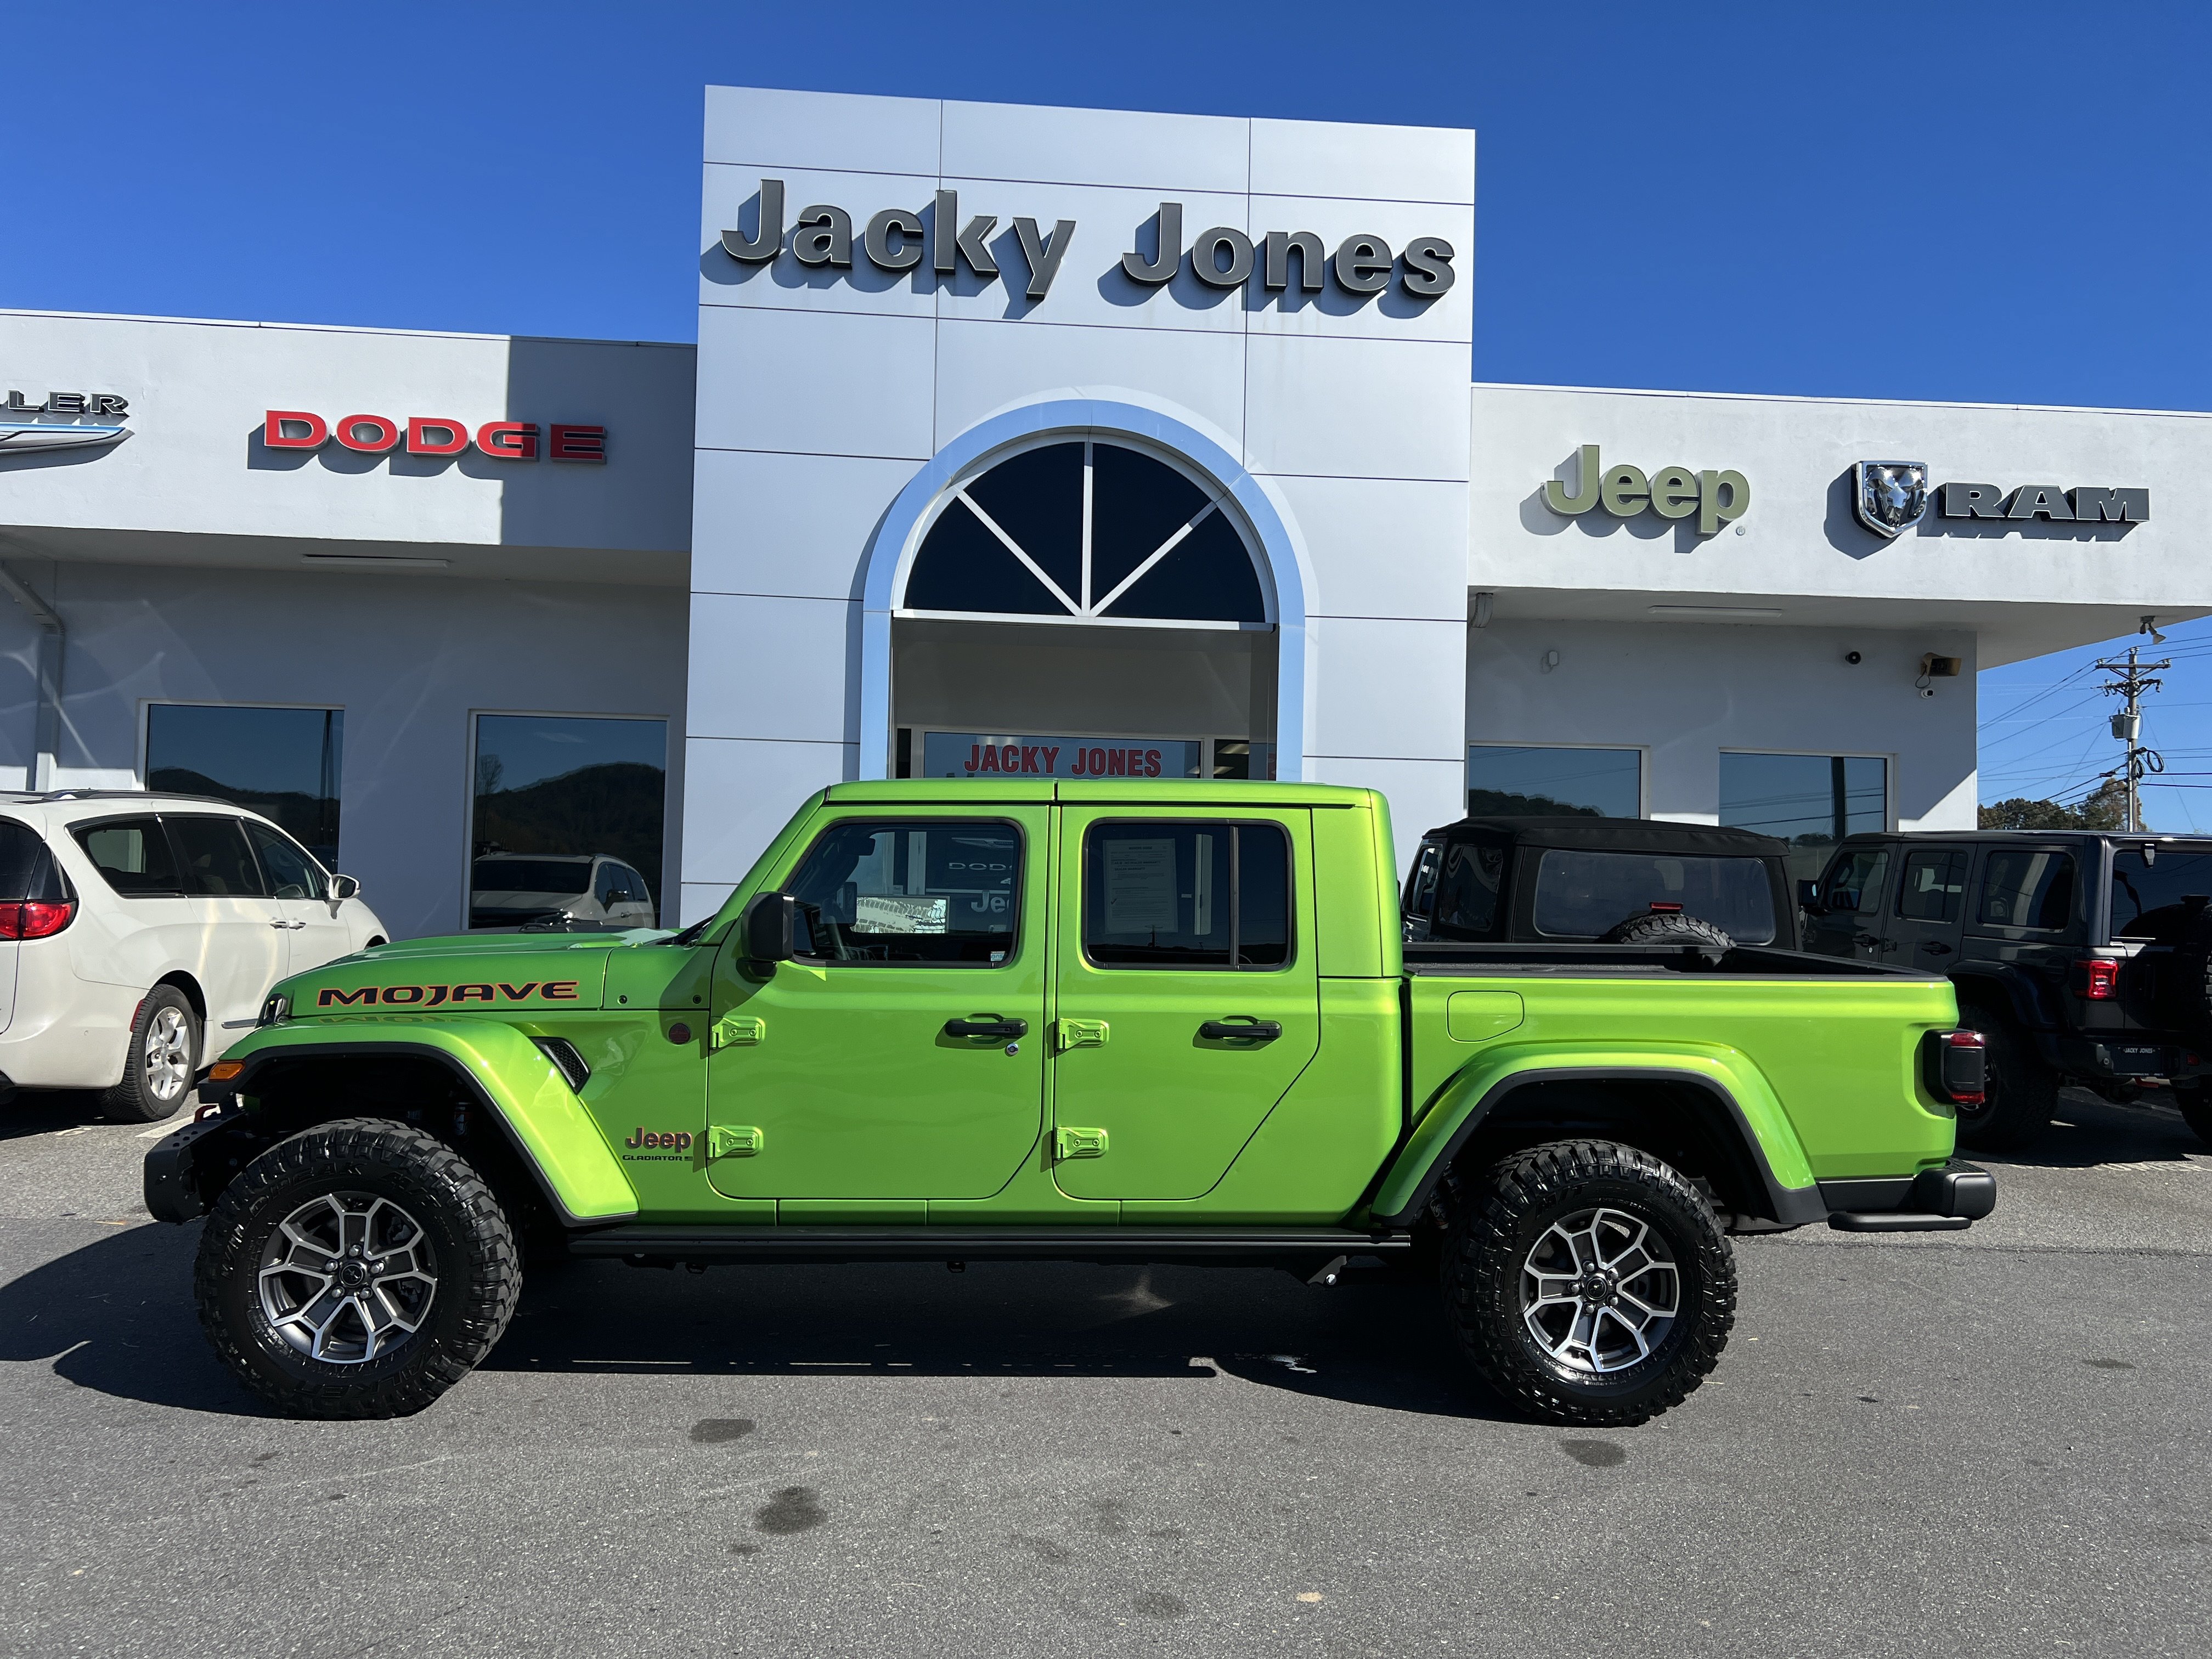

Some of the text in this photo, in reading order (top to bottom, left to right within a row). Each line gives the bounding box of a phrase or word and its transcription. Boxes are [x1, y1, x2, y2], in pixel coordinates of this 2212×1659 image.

[720, 178, 1455, 300] Jacky Jones
[4, 390, 129, 414] LER
[264, 410, 606, 462] DODGE
[1541, 444, 1751, 535] Jeep
[1942, 482, 2150, 523] RAM
[963, 744, 1162, 778] JACKY JONES
[970, 890, 1009, 913] Je
[316, 980, 580, 1008] MOJAVE
[625, 1126, 693, 1153] Jeep
